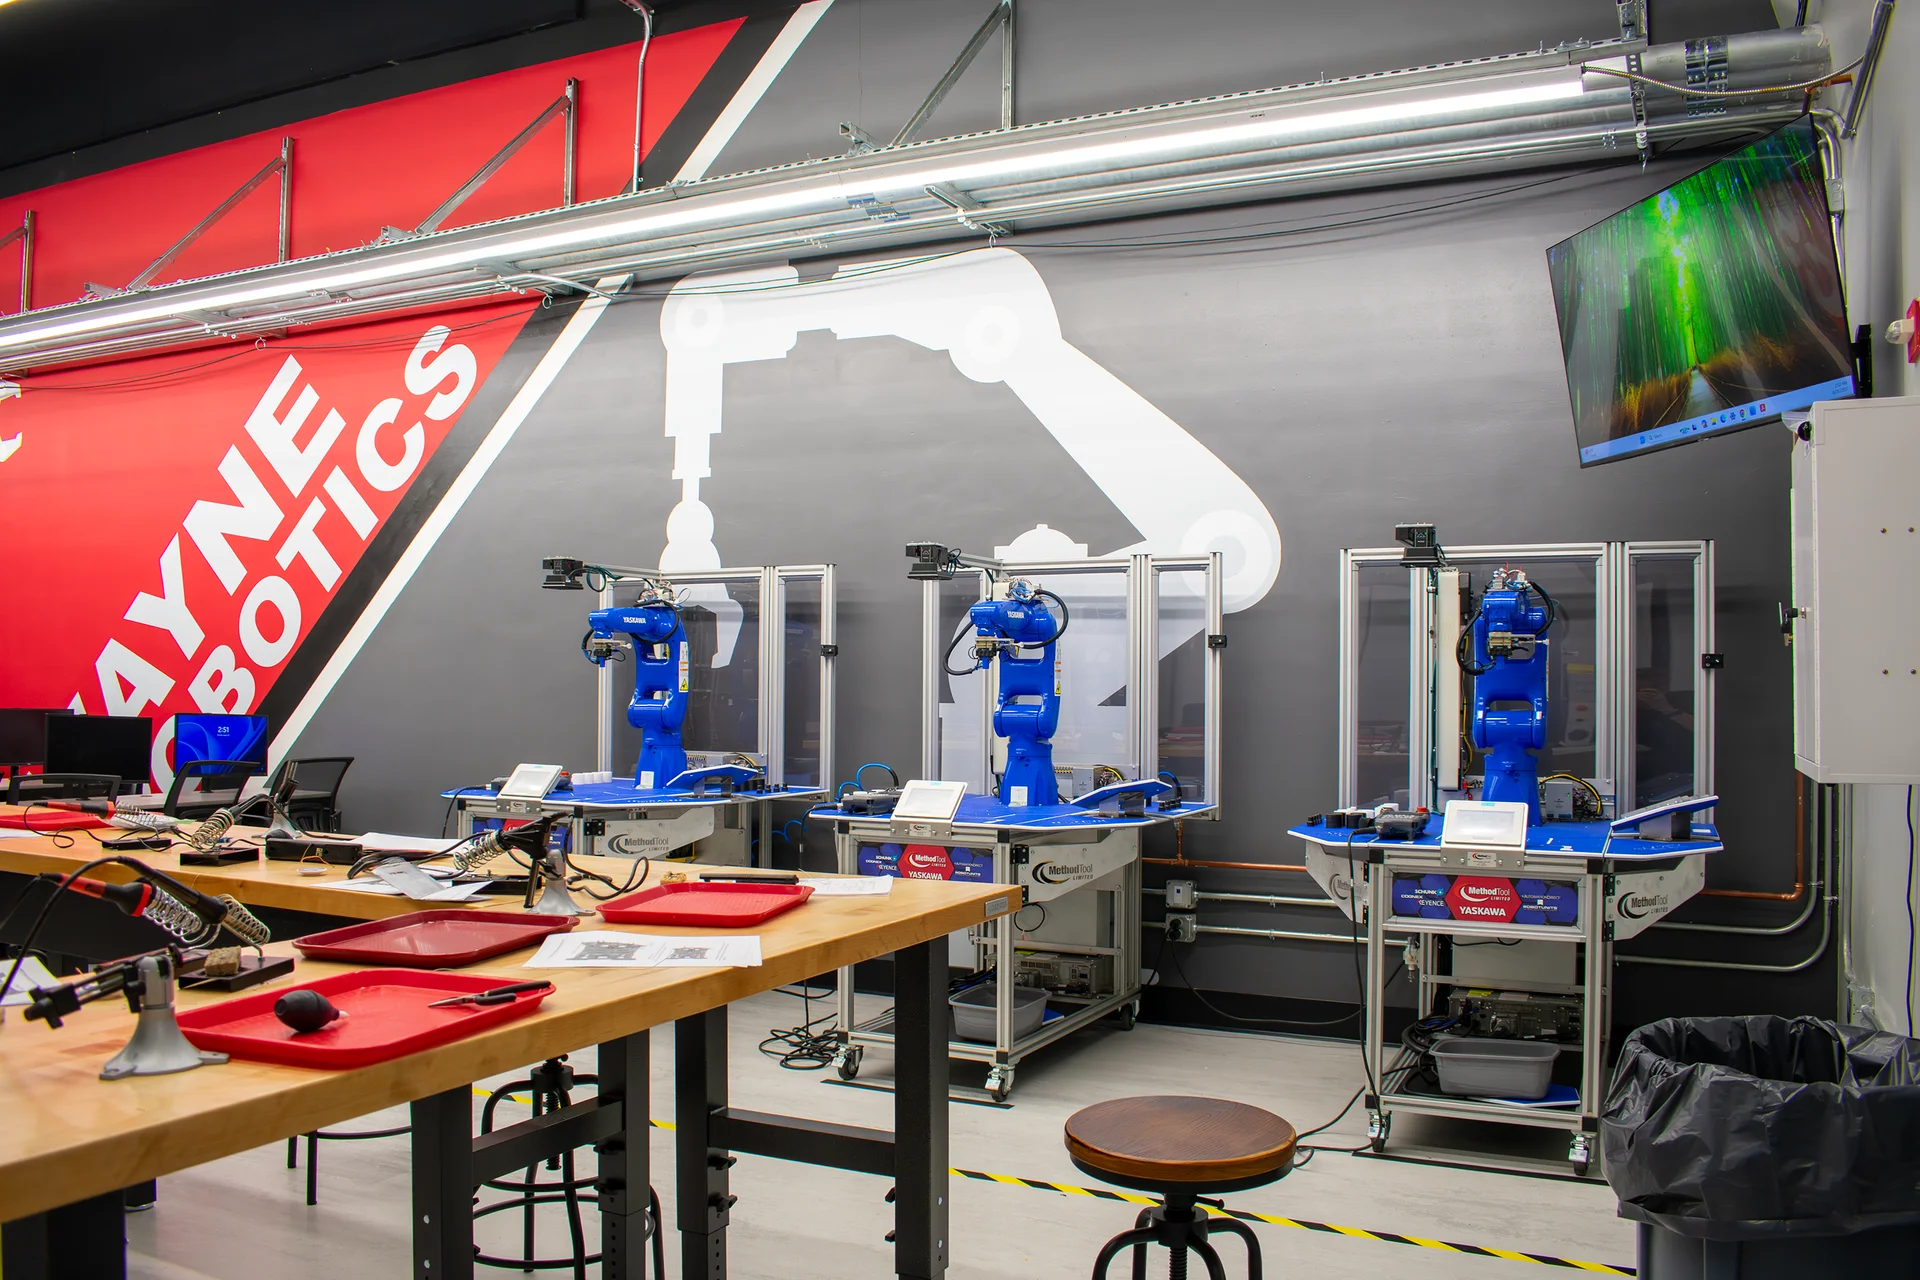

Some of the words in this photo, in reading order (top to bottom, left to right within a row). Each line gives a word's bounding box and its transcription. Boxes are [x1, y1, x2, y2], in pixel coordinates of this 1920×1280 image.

[67, 354, 346, 716] AYNE
[624, 837, 669, 846] MethodTool
[915, 854, 946, 863] MethodTool
[1049, 865, 1092, 875] MethodTool
[908, 871, 943, 880] YASKAWA
[1468, 886, 1511, 896] MethodTool
[1631, 895, 1668, 908] MethodTool
[1459, 906, 1506, 917] YASKAWA
